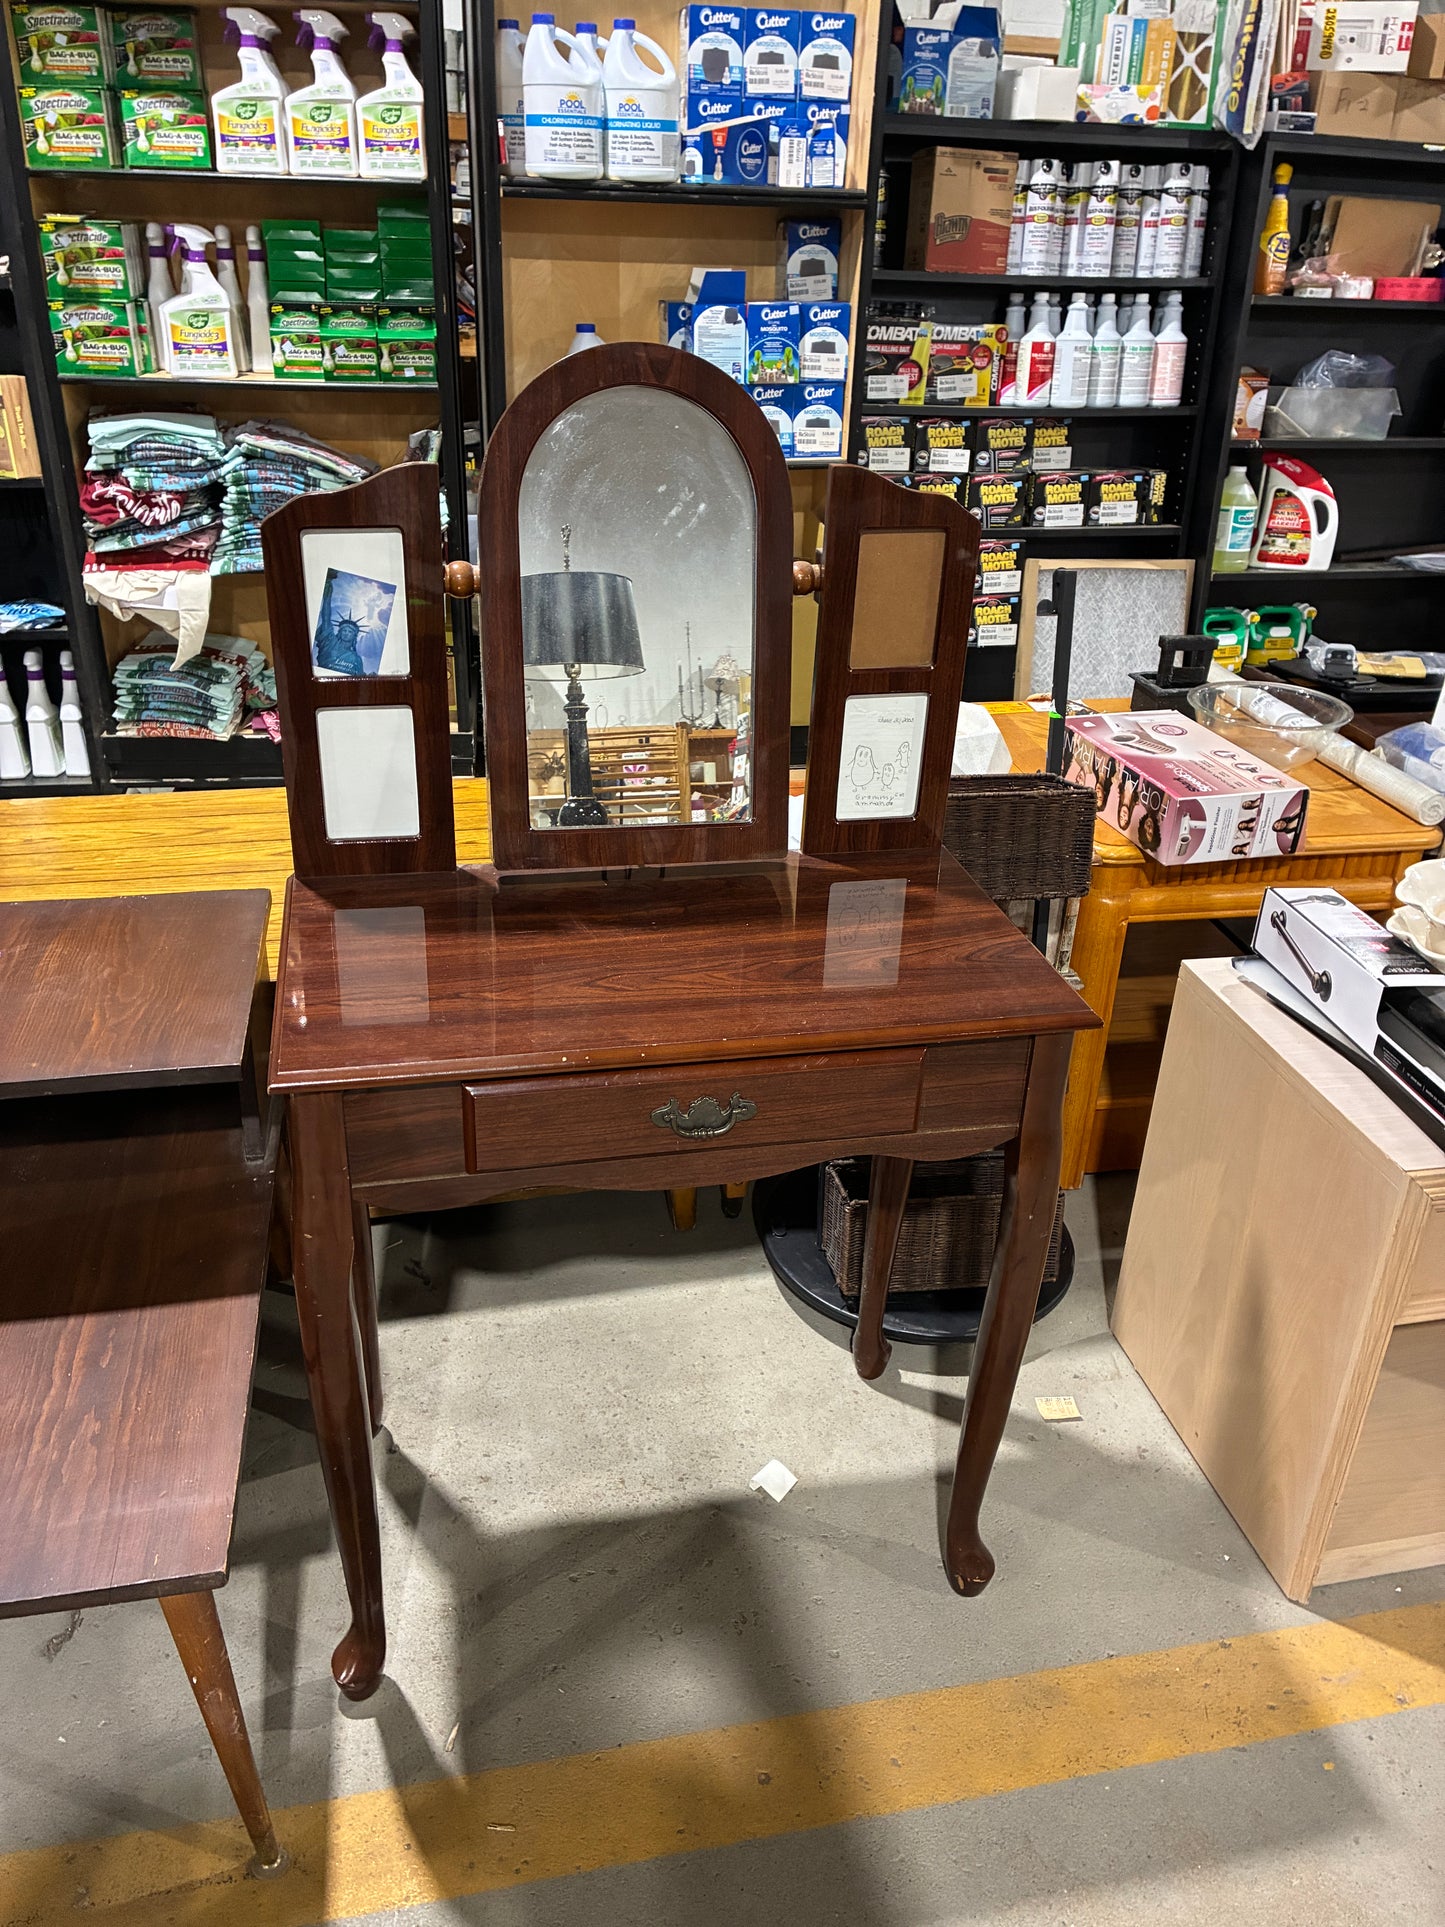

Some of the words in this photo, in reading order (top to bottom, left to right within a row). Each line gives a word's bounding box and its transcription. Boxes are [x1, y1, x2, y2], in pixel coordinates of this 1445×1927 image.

[27, 15, 82, 28] Spectracide
[700, 9, 734, 25] Cutter
[756, 12, 790, 30] Cutter
[812, 15, 845, 32] Cutter
[1385, 16, 1400, 55] HALO
[49, 51, 96, 59] BAG-A-BUG
[145, 56, 190, 64] BAG-A-BUG
[34, 97, 89, 112] Spectracide
[136, 97, 191, 112] Spectracide
[560, 99, 585, 108] POOL
[618, 103, 642, 112] POOL
[699, 101, 732, 116] Cutter
[754, 104, 786, 117] Cutter
[808, 106, 840, 121] Cutter
[227, 120, 262, 132] Fungicide
[262, 123, 268, 132] 3
[301, 123, 336, 135] Fungicide
[336, 125, 342, 134] 3
[372, 124, 406, 136] Fungicide
[406, 127, 412, 137] 3
[55, 132, 101, 140] BAG-A-BUG
[157, 132, 203, 140] BAG-A-BUG
[799, 224, 830, 239] Cutter
[54, 231, 109, 247] Sctracide
[75, 265, 121, 273] BAG-A-BUG
[761, 308, 788, 321] Cutter
[809, 306, 841, 322] Cutter
[282, 319, 319, 330] Spectracide
[330, 319, 368, 331] Spectracide
[387, 319, 425, 330] Spectracide
[180, 329, 214, 342] Fungicide
[214, 332, 220, 341] 3
[866, 325, 919, 341] OMBAT
[932, 325, 984, 341] OMBAT
[83, 343, 128, 351] BAG-A-BUG
[991, 352, 1001, 391] COMBAT
[755, 387, 784, 401] Cutter
[805, 387, 835, 401] Cutter
[866, 427, 904, 438] ROACH
[927, 427, 965, 438] ROACH
[988, 428, 1026, 438] ROACH
[1034, 427, 1068, 437] ROACH
[867, 436, 905, 448] MOTEL
[929, 437, 965, 448] MOTEL
[990, 437, 1027, 449] MOTEL
[1033, 436, 1068, 447] MOTEL
[919, 483, 957, 494] ROACH
[980, 483, 1017, 495] ROACH
[1046, 483, 1082, 494] ROACH
[1101, 482, 1136, 493] ROACH
[1151, 474, 1160, 505] MOTEL
[1158, 472, 1168, 506] ROACH
[981, 494, 1018, 505] MOTEL
[1047, 493, 1082, 504] MOTEL
[1102, 491, 1136, 502] MOTEL
[981, 551, 1017, 563] ROACH
[982, 561, 1017, 572] MOTEL
[975, 604, 1012, 616] ROACH
[976, 614, 1011, 625] MOTEL
[1063, 731, 1112, 778] HAIRKIN
[1140, 784, 1171, 819] FOR
